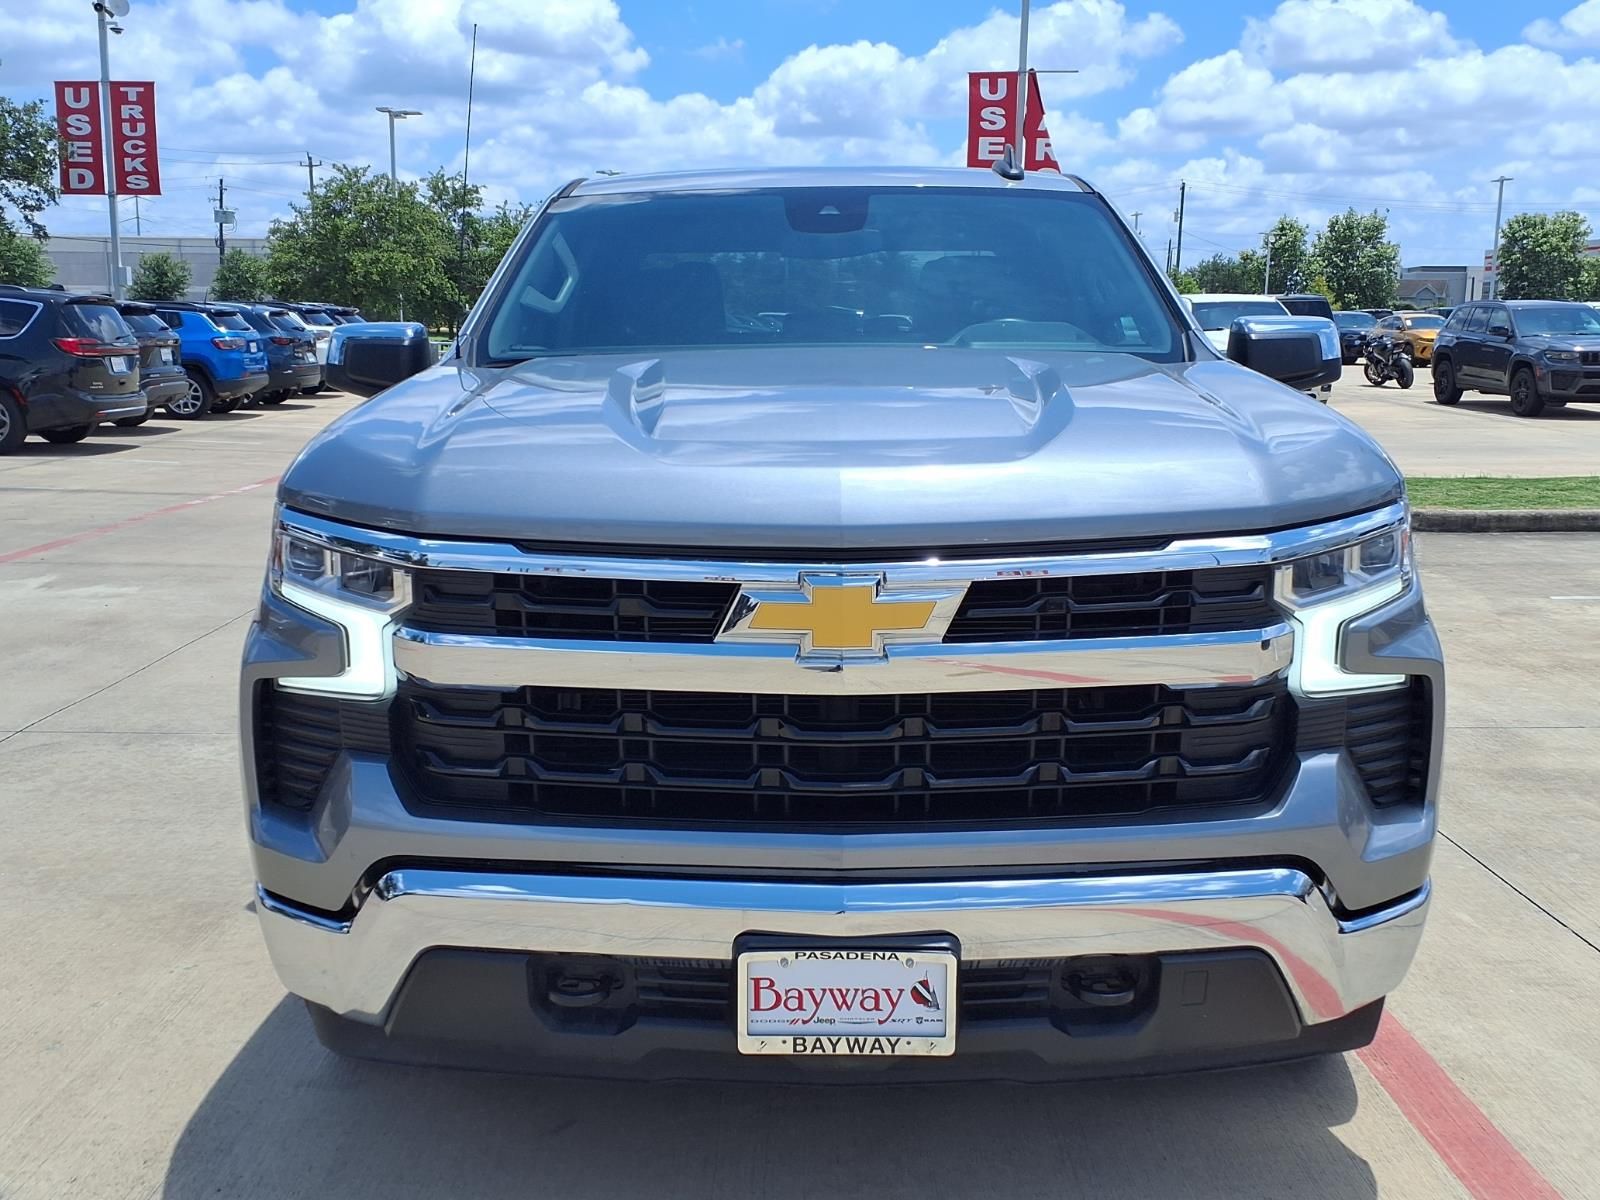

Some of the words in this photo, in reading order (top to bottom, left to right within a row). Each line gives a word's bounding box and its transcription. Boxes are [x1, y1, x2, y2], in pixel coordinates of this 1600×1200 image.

[64, 87, 95, 189] USED
[119, 86, 150, 189] TRUCKS
[794, 951, 899, 961] PASADENA
[750, 977, 905, 1025] Bayway
[813, 1016, 836, 1025] Jeep
[792, 1037, 901, 1054] BAYWAY
